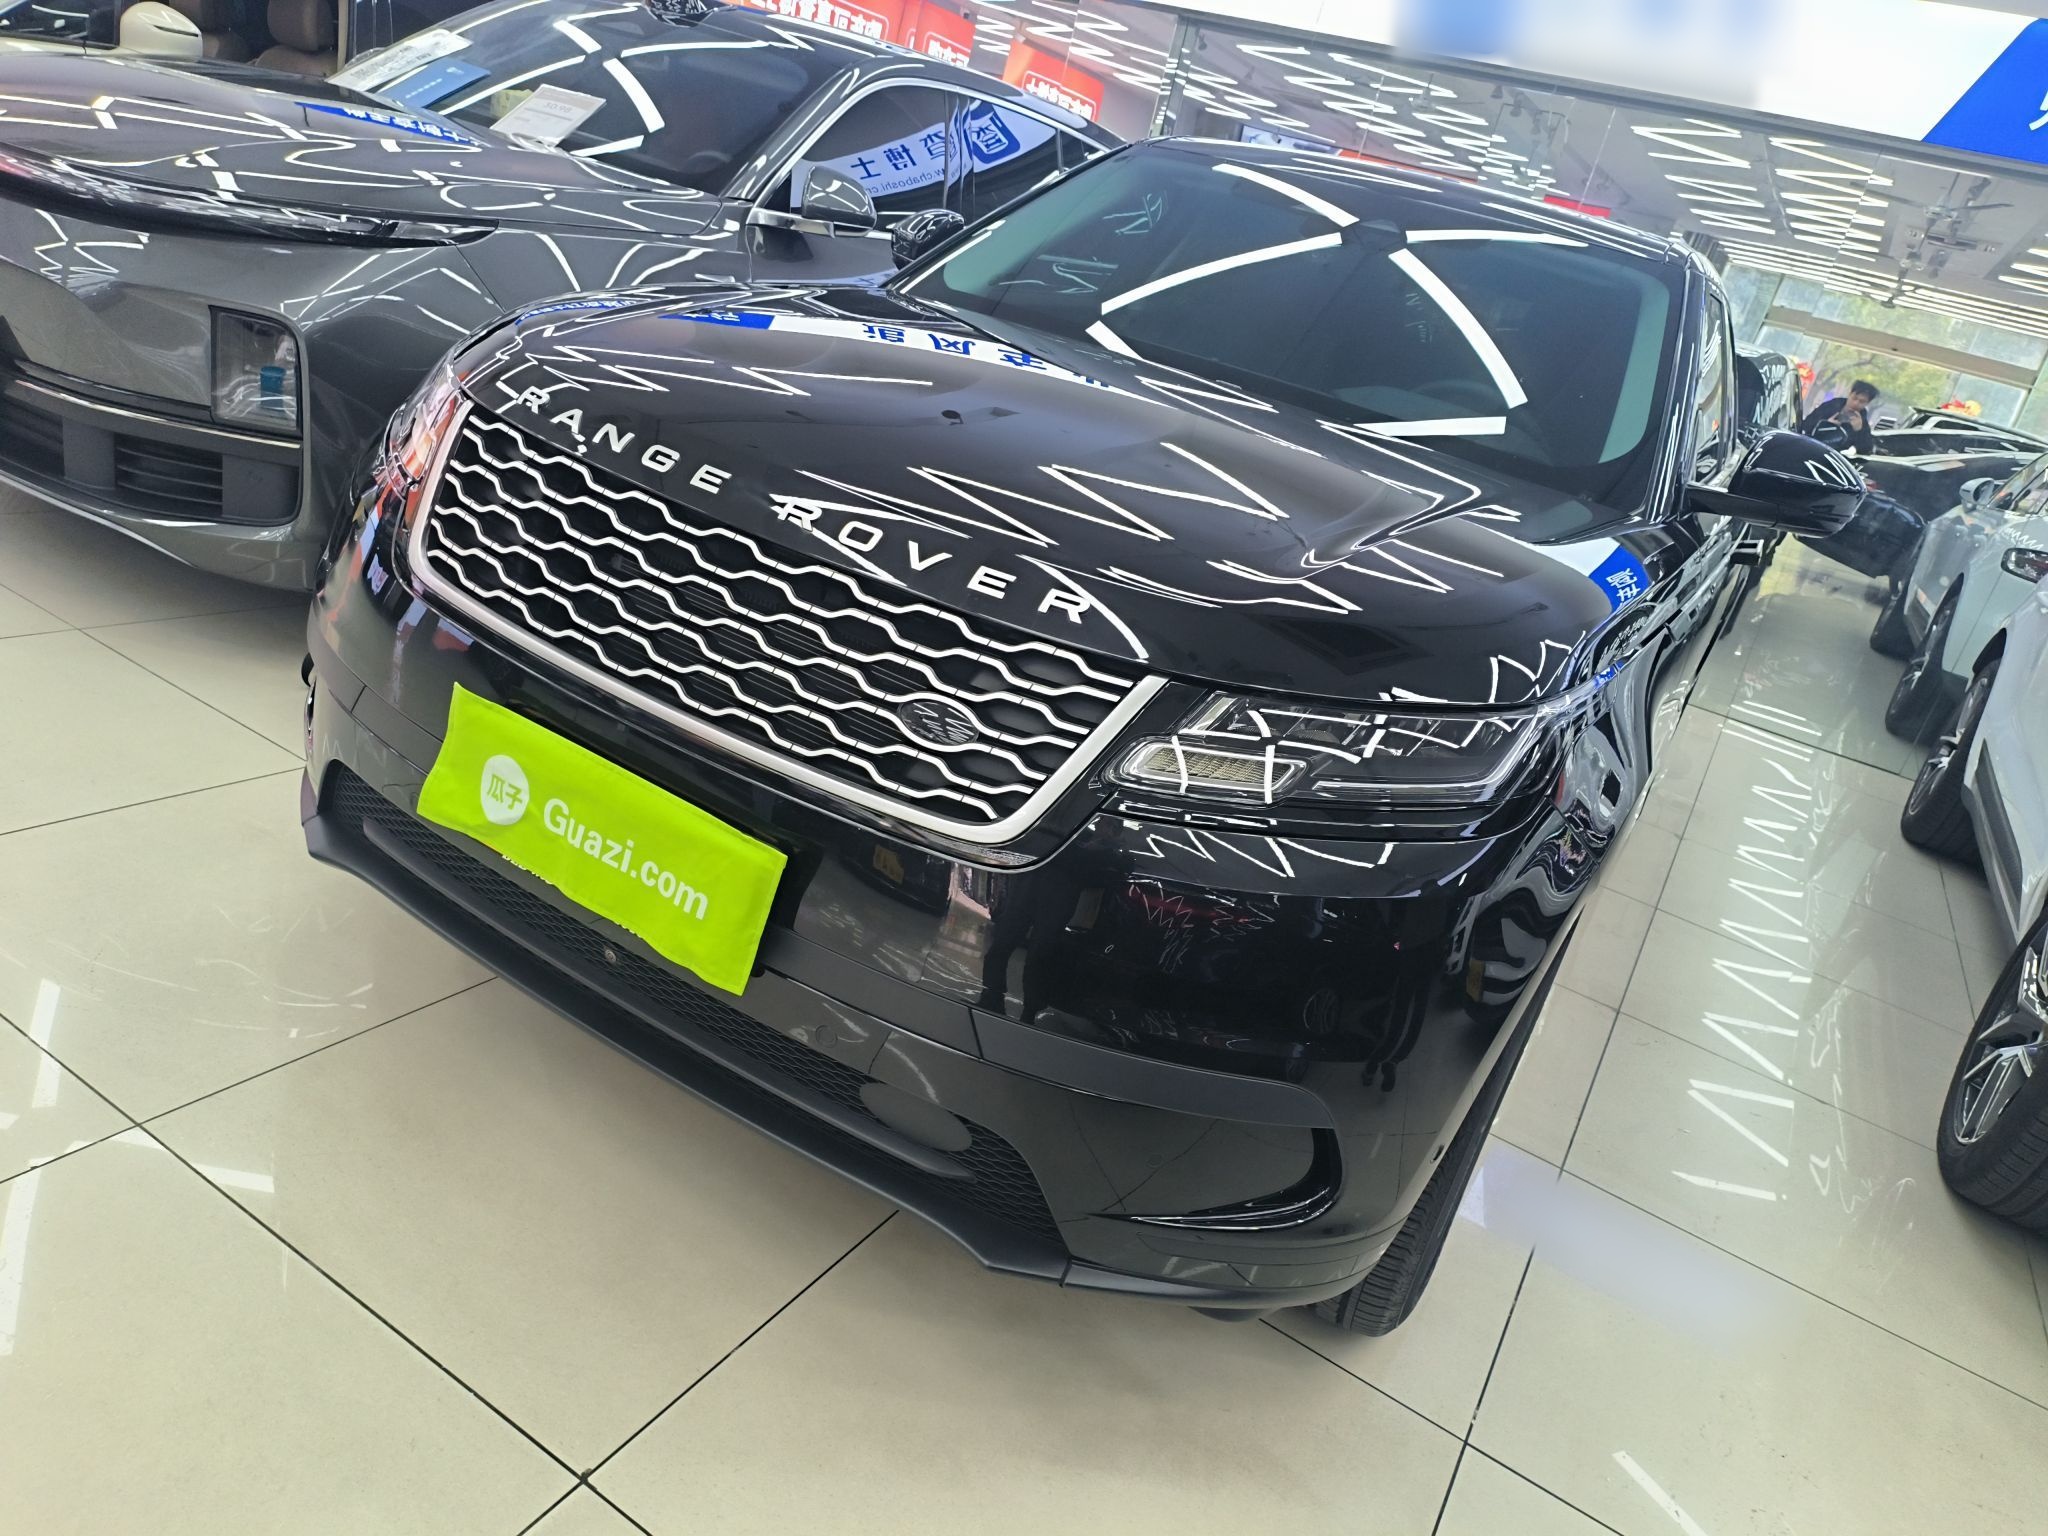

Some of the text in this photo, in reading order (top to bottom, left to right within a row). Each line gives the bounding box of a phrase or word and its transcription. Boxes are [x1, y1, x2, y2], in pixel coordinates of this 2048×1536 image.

[516, 386, 1091, 624] RANGE ROVER
[486, 773, 524, 811] 瓜子
[543, 798, 709, 920] Guazi.com
